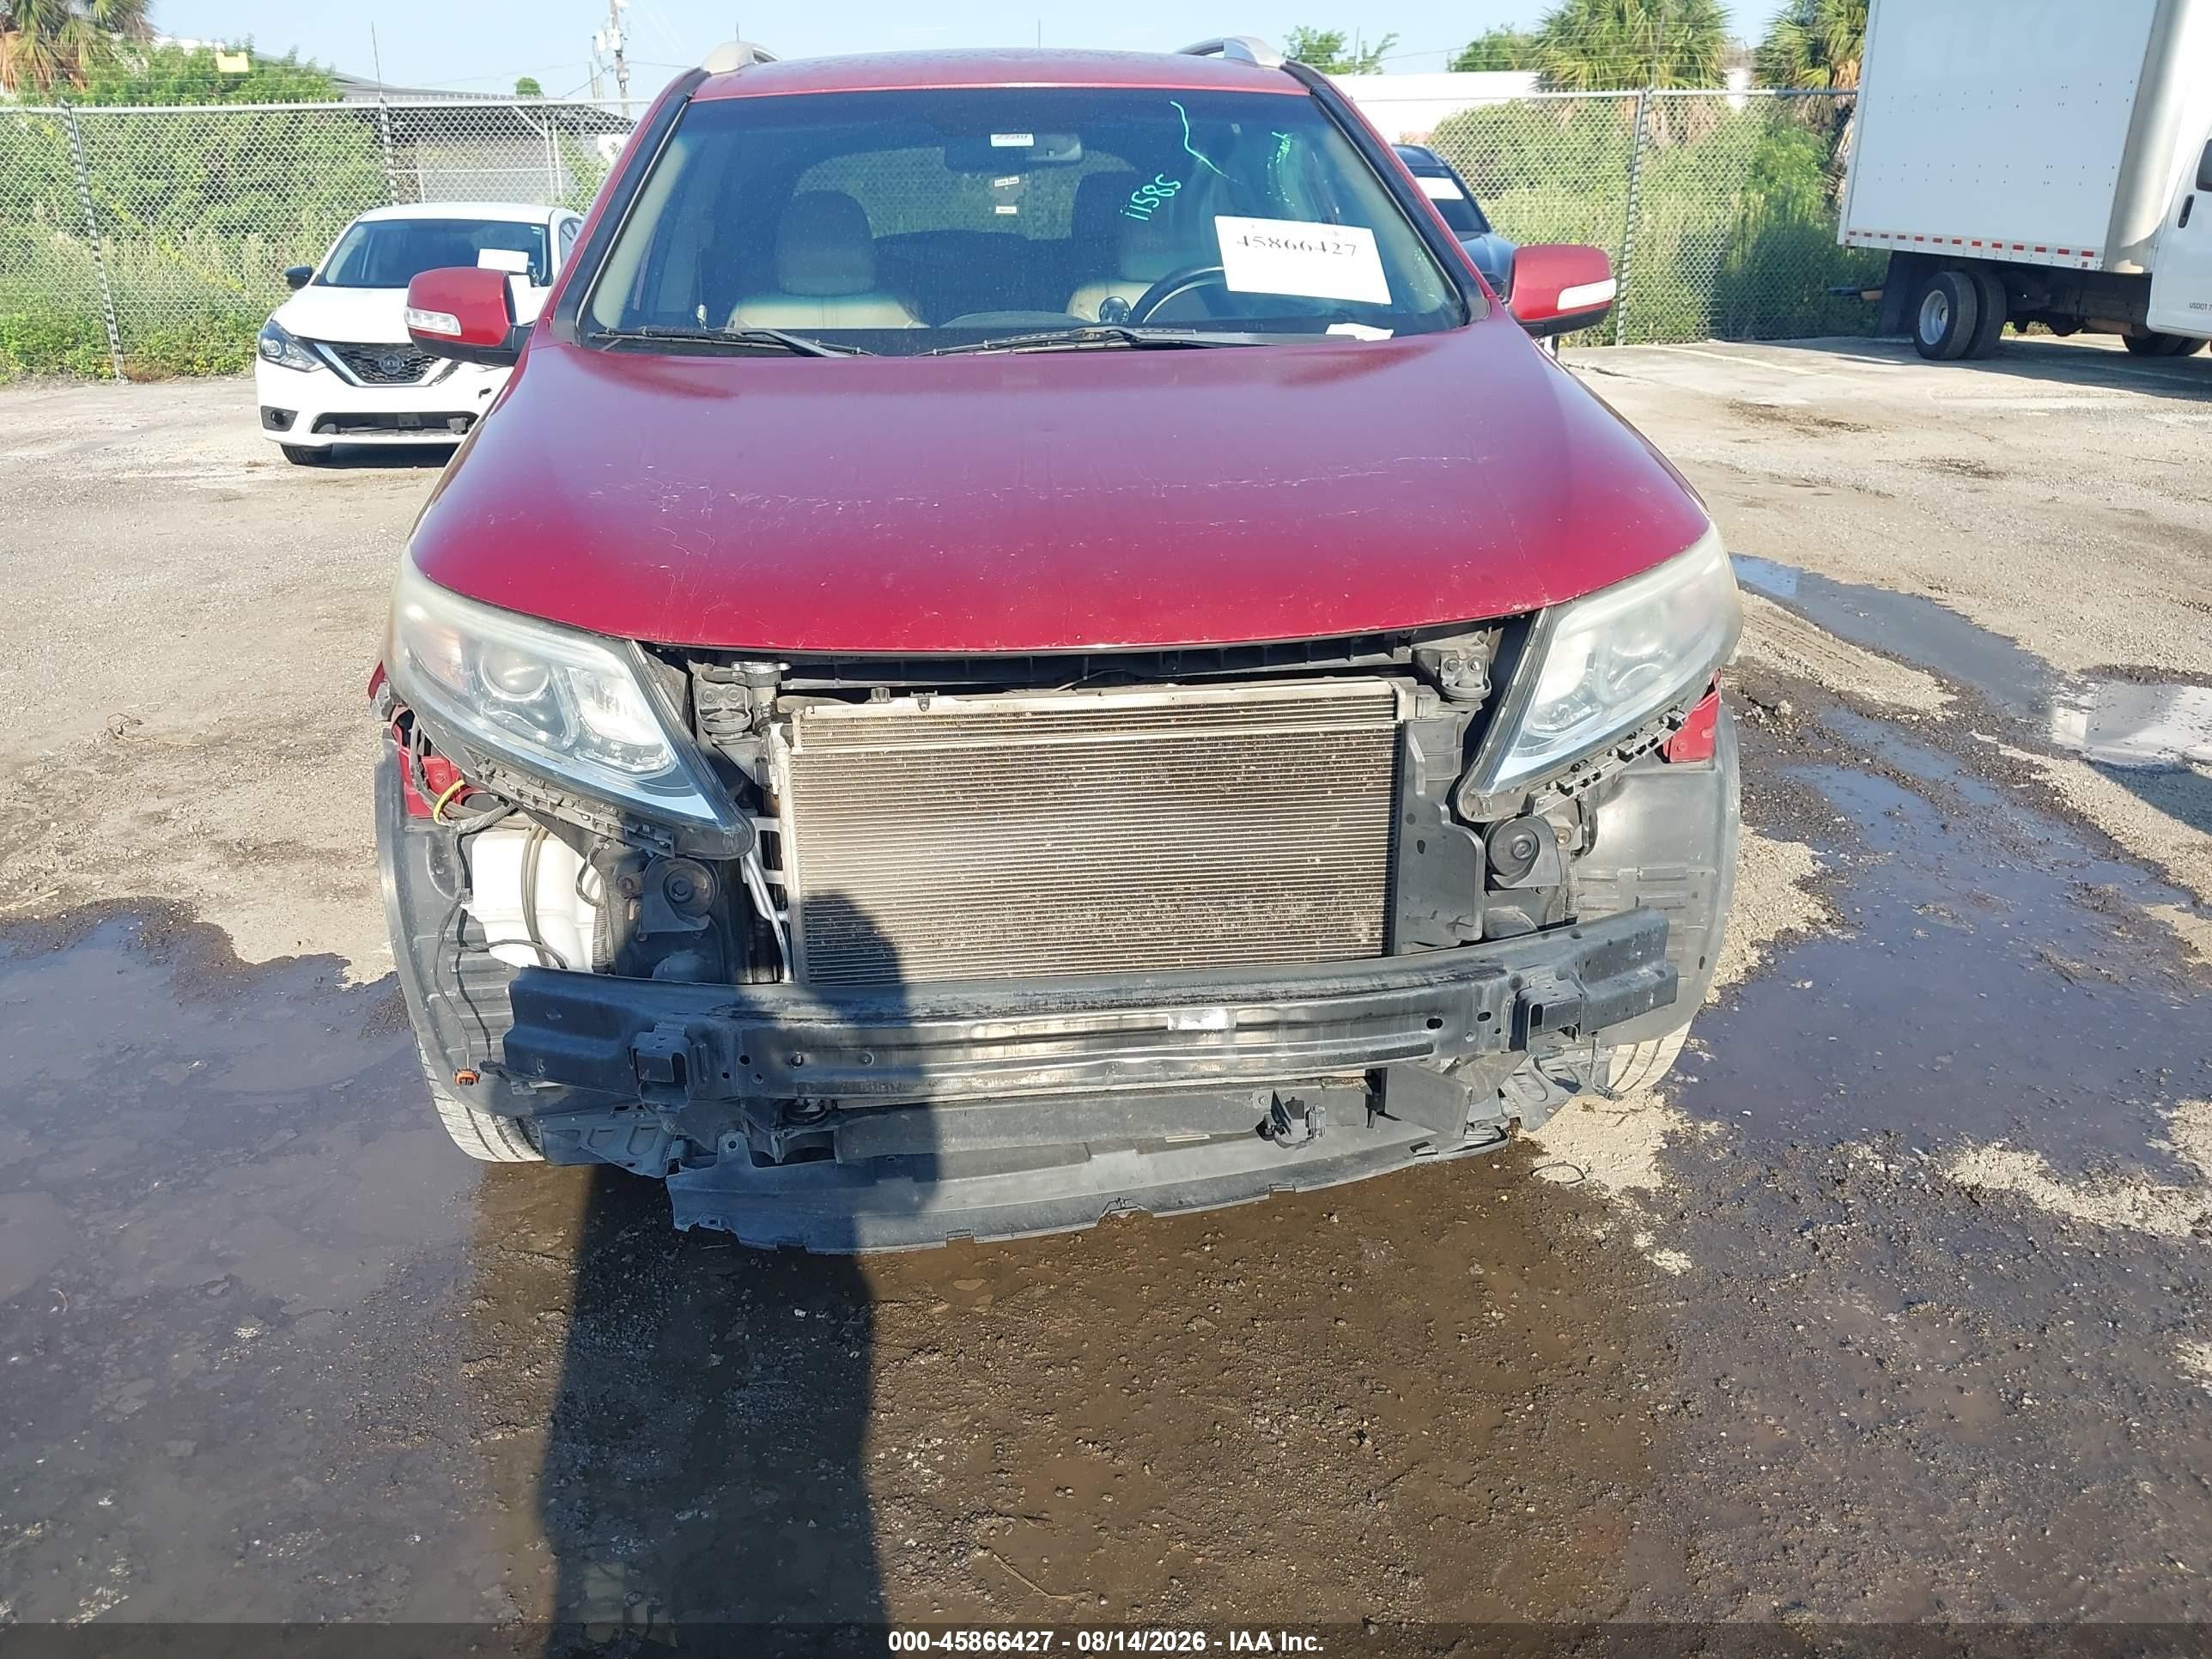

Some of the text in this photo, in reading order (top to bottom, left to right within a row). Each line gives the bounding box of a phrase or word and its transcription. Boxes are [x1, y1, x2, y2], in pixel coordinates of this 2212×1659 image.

[1124, 173, 1182, 221] 11585
[1237, 234, 1357, 257] 45866427
[2189, 301, 2208, 311] USDOT
